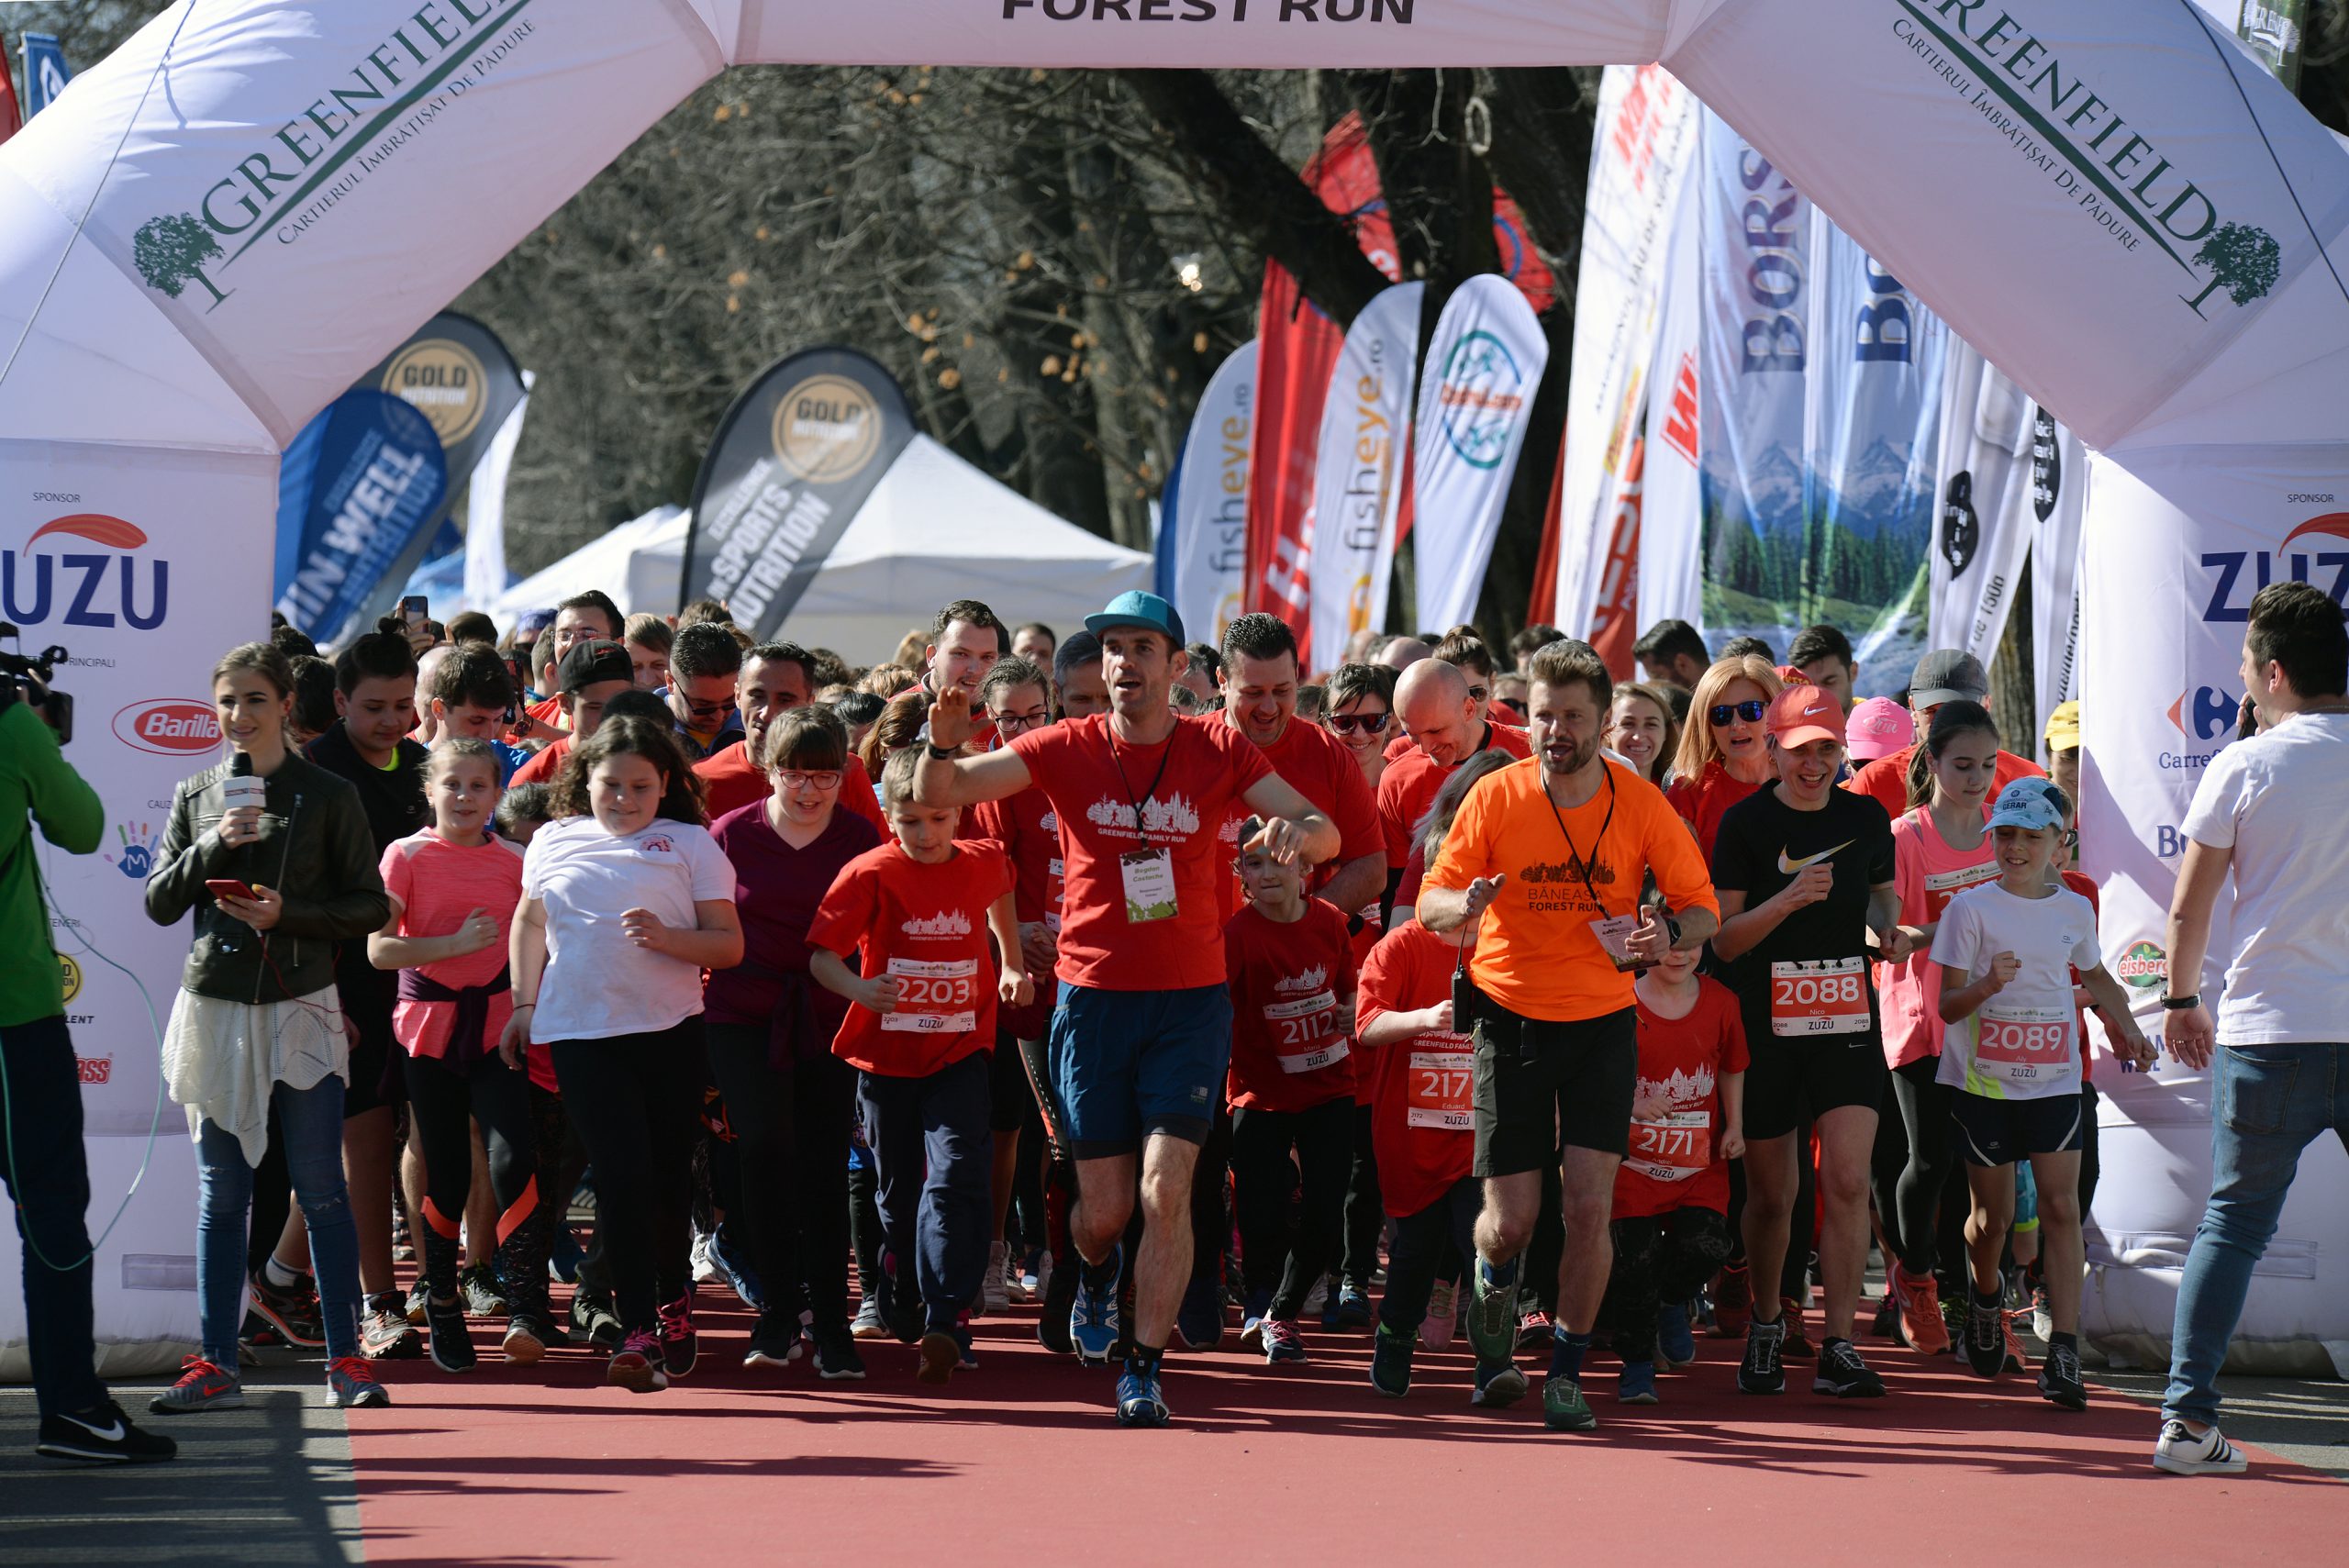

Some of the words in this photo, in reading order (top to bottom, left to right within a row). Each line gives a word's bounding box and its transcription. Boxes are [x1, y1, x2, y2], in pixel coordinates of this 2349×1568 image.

[1002, 0, 1247, 20] FOREST
[1278, 0, 1413, 24] RUN
[202, 0, 511, 235] GREENFIEL
[1918, 0, 2217, 241] REENFIELD
[1893, 18, 1973, 97] CARTIERUL
[2054, 169, 2082, 197] DE
[2078, 192, 2141, 252] PĂDURE
[277, 172, 362, 244] CARTIERUL
[404, 365, 468, 388] GOLD
[33, 492, 81, 503] SPONSOR
[2288, 493, 2334, 504] SPONSOR
[711, 482, 794, 585] SPORTS
[69, 657, 116, 668] RINCIPALI
[144, 712, 219, 739] Barilla
[1171, 835, 1186, 843] RUN
[1529, 902, 1575, 911] FOREST
[896, 978, 970, 1005] 2203
[1776, 976, 1859, 1006] 2088
[918, 1018, 944, 1029] ZUZU
[1281, 1010, 1334, 1044] 2112
[1808, 1019, 1834, 1030] ZUZU
[1413, 1040, 1454, 1050] GREENFIELD
[1982, 1022, 2063, 1051] 2089
[1306, 1053, 1329, 1066] ZUZU
[2010, 1067, 2037, 1078] ZUZU
[1420, 1072, 1474, 1098] 217
[1442, 1102, 1465, 1110] Eduard
[1444, 1115, 1470, 1126] ZUZU
[1637, 1128, 1693, 1156] 2171
[1648, 1166, 1675, 1179] ZUZU
